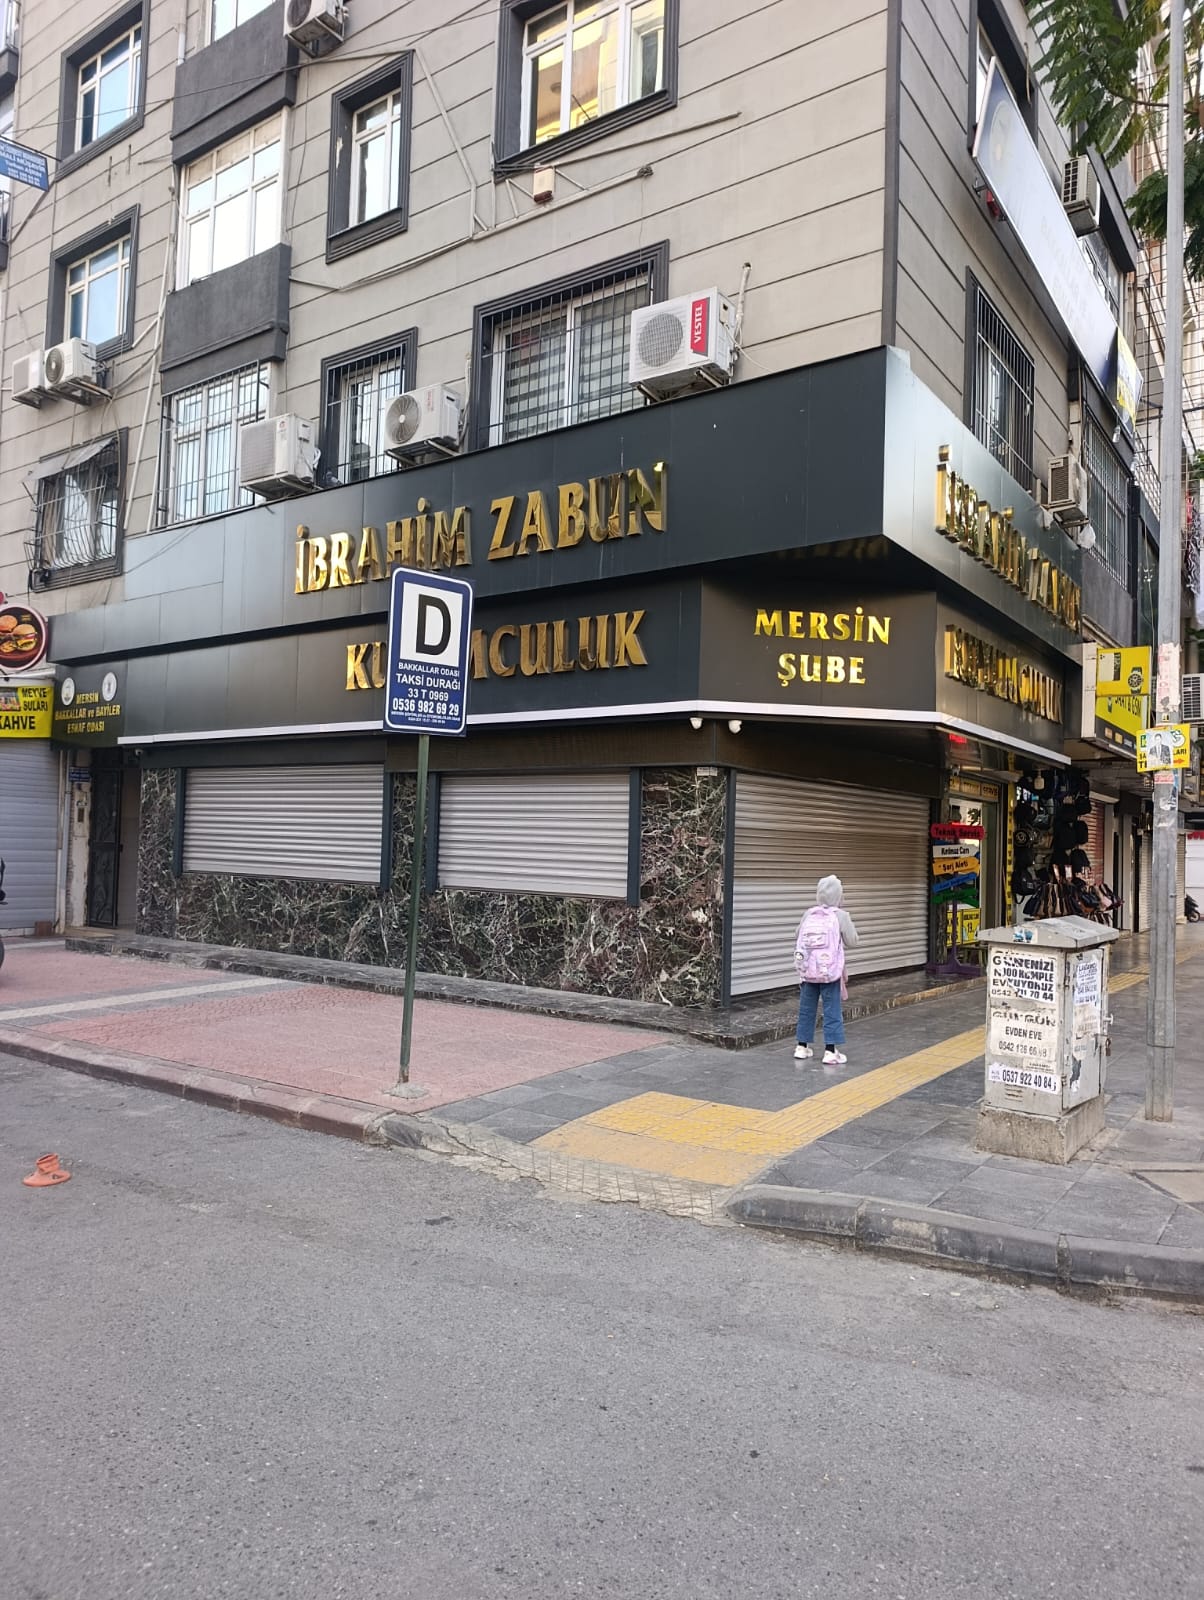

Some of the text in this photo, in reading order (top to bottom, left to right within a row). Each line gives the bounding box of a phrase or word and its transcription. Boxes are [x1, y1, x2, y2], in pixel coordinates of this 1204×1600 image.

[694, 304, 703, 344] VESTEL
[295, 461, 667, 593] İBRAHİM ZABUN
[416, 593, 452, 656] D
[754, 606, 891, 645] MERSİN
[398, 662, 460, 677] BAKKALLAR ODASI
[777, 653, 866, 687] ŞUBE
[396, 673, 461, 691] TAKSİ DURAĞI
[21, 687, 48, 698] MEYVE
[408, 688, 449, 702] 33 T 0969
[23, 700, 48, 711] SULARI
[392, 697, 415, 712] 0536
[418, 700, 434, 714] 982
[436, 702, 447, 715] 69
[449, 703, 459, 716] 29
[1005, 1026, 1043, 1041] EVDEN EVE
[1002, 1069, 1019, 1084] 0537
[1020, 1071, 1032, 1086] 922
[1033, 1074, 1042, 1088] 40
[1043, 1076, 1052, 1089] 84
